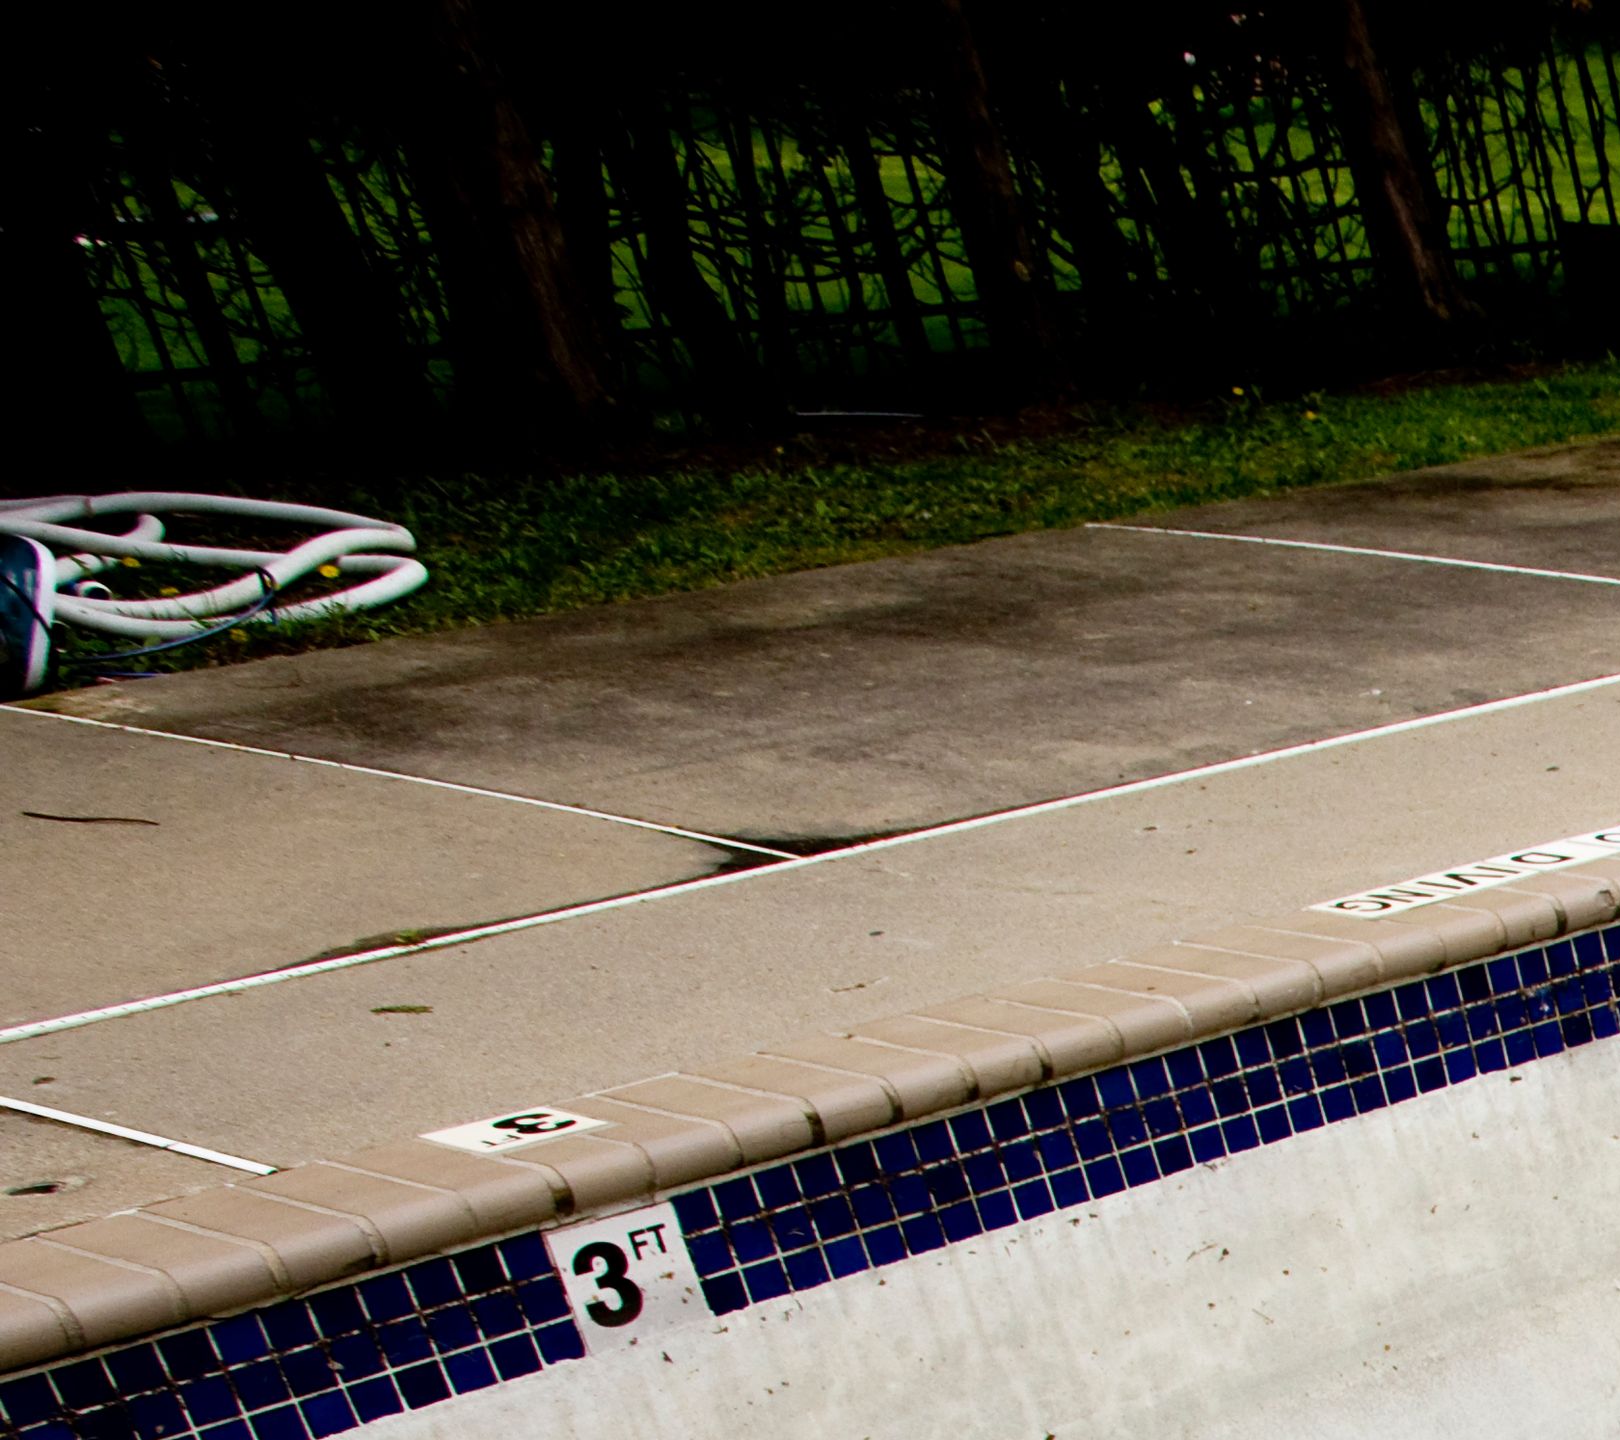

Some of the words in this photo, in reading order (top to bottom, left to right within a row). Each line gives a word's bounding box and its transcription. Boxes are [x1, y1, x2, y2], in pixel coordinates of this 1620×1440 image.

[1334, 851, 1575, 914] DIVING
[492, 1113, 577, 1135] 3
[572, 1241, 644, 1328] 3
[628, 1224, 668, 1261] FT
